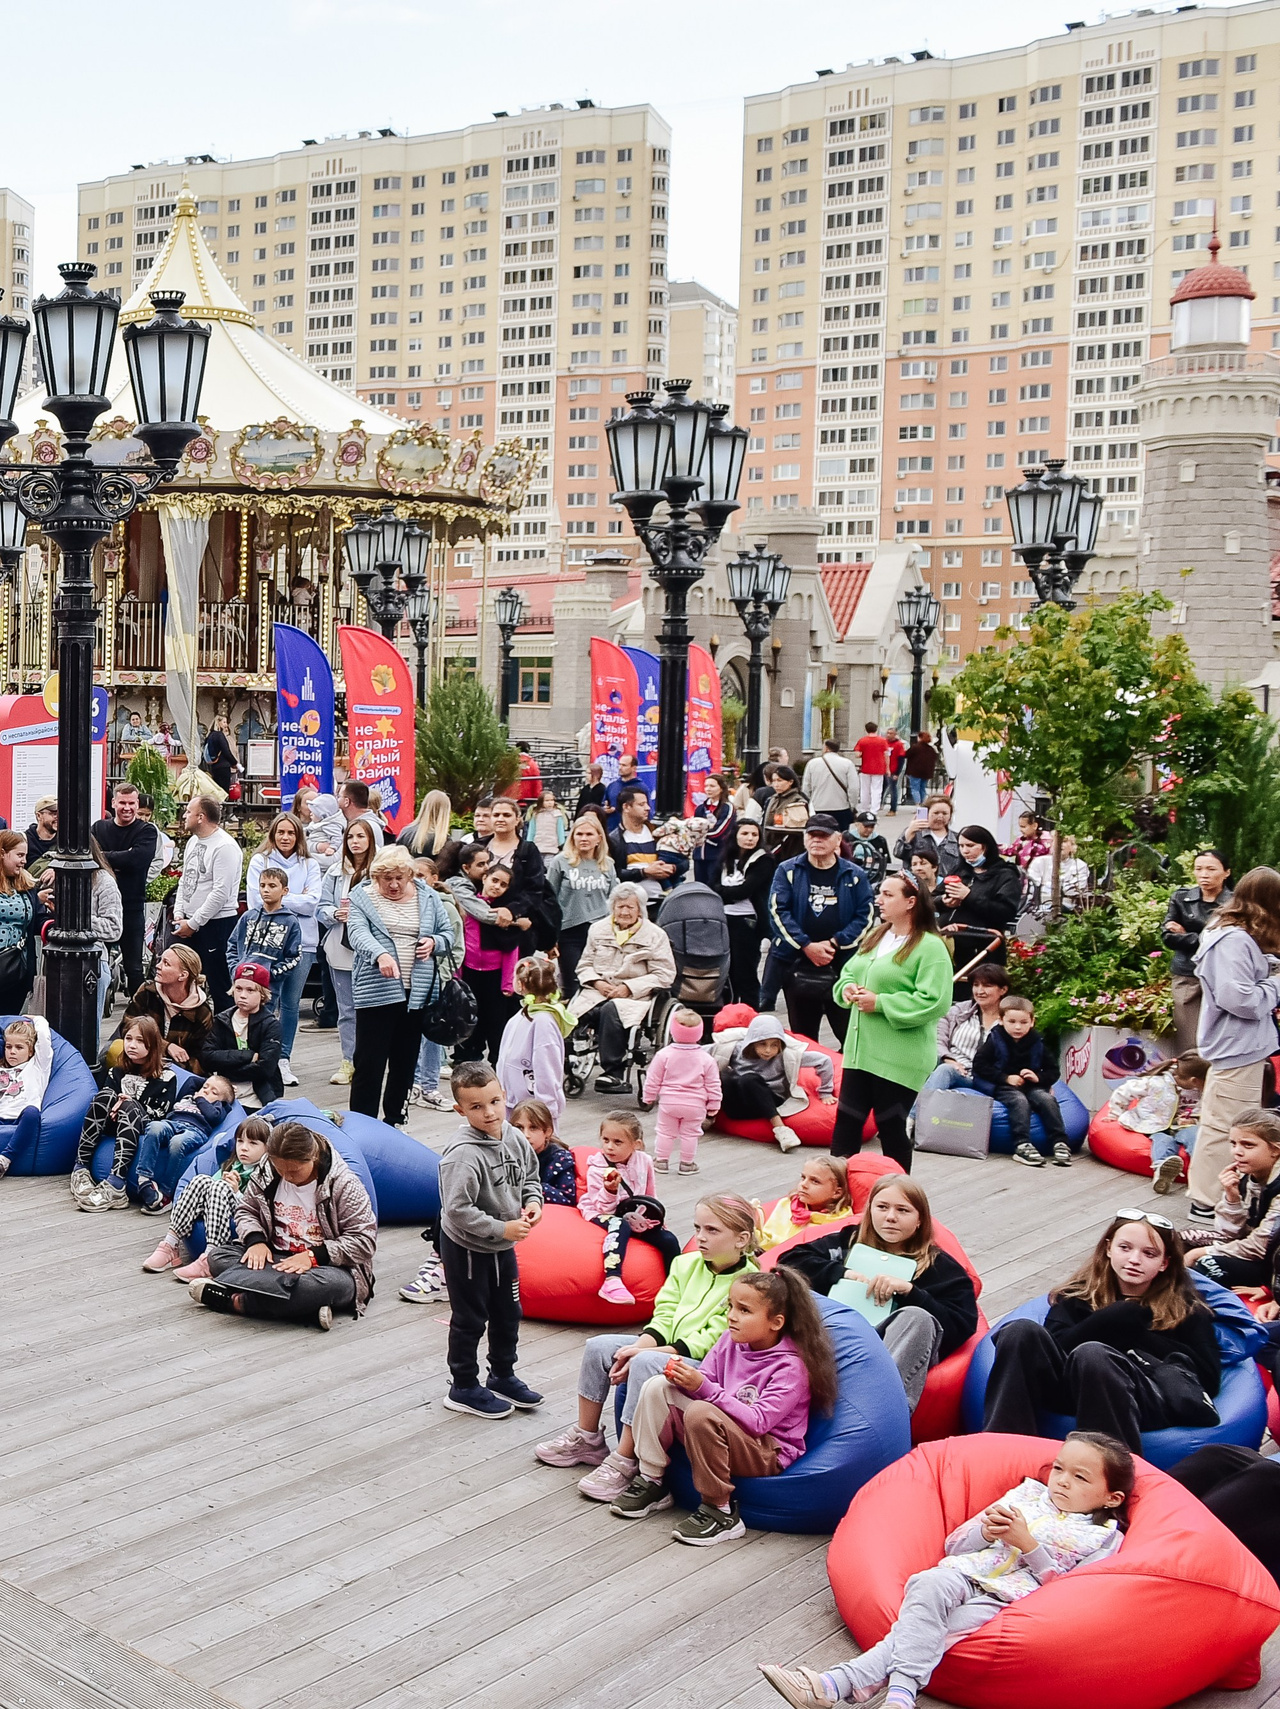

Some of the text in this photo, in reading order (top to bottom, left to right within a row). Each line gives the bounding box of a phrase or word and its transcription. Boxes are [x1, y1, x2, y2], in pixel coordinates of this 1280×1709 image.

[282, 736, 325, 748] спаль-
[355, 738, 404, 750] спаль-
[594, 733, 628, 744] район
[296, 749, 322, 762] ный
[371, 749, 401, 764] ный
[282, 762, 322, 776] район
[356, 765, 400, 781] район
